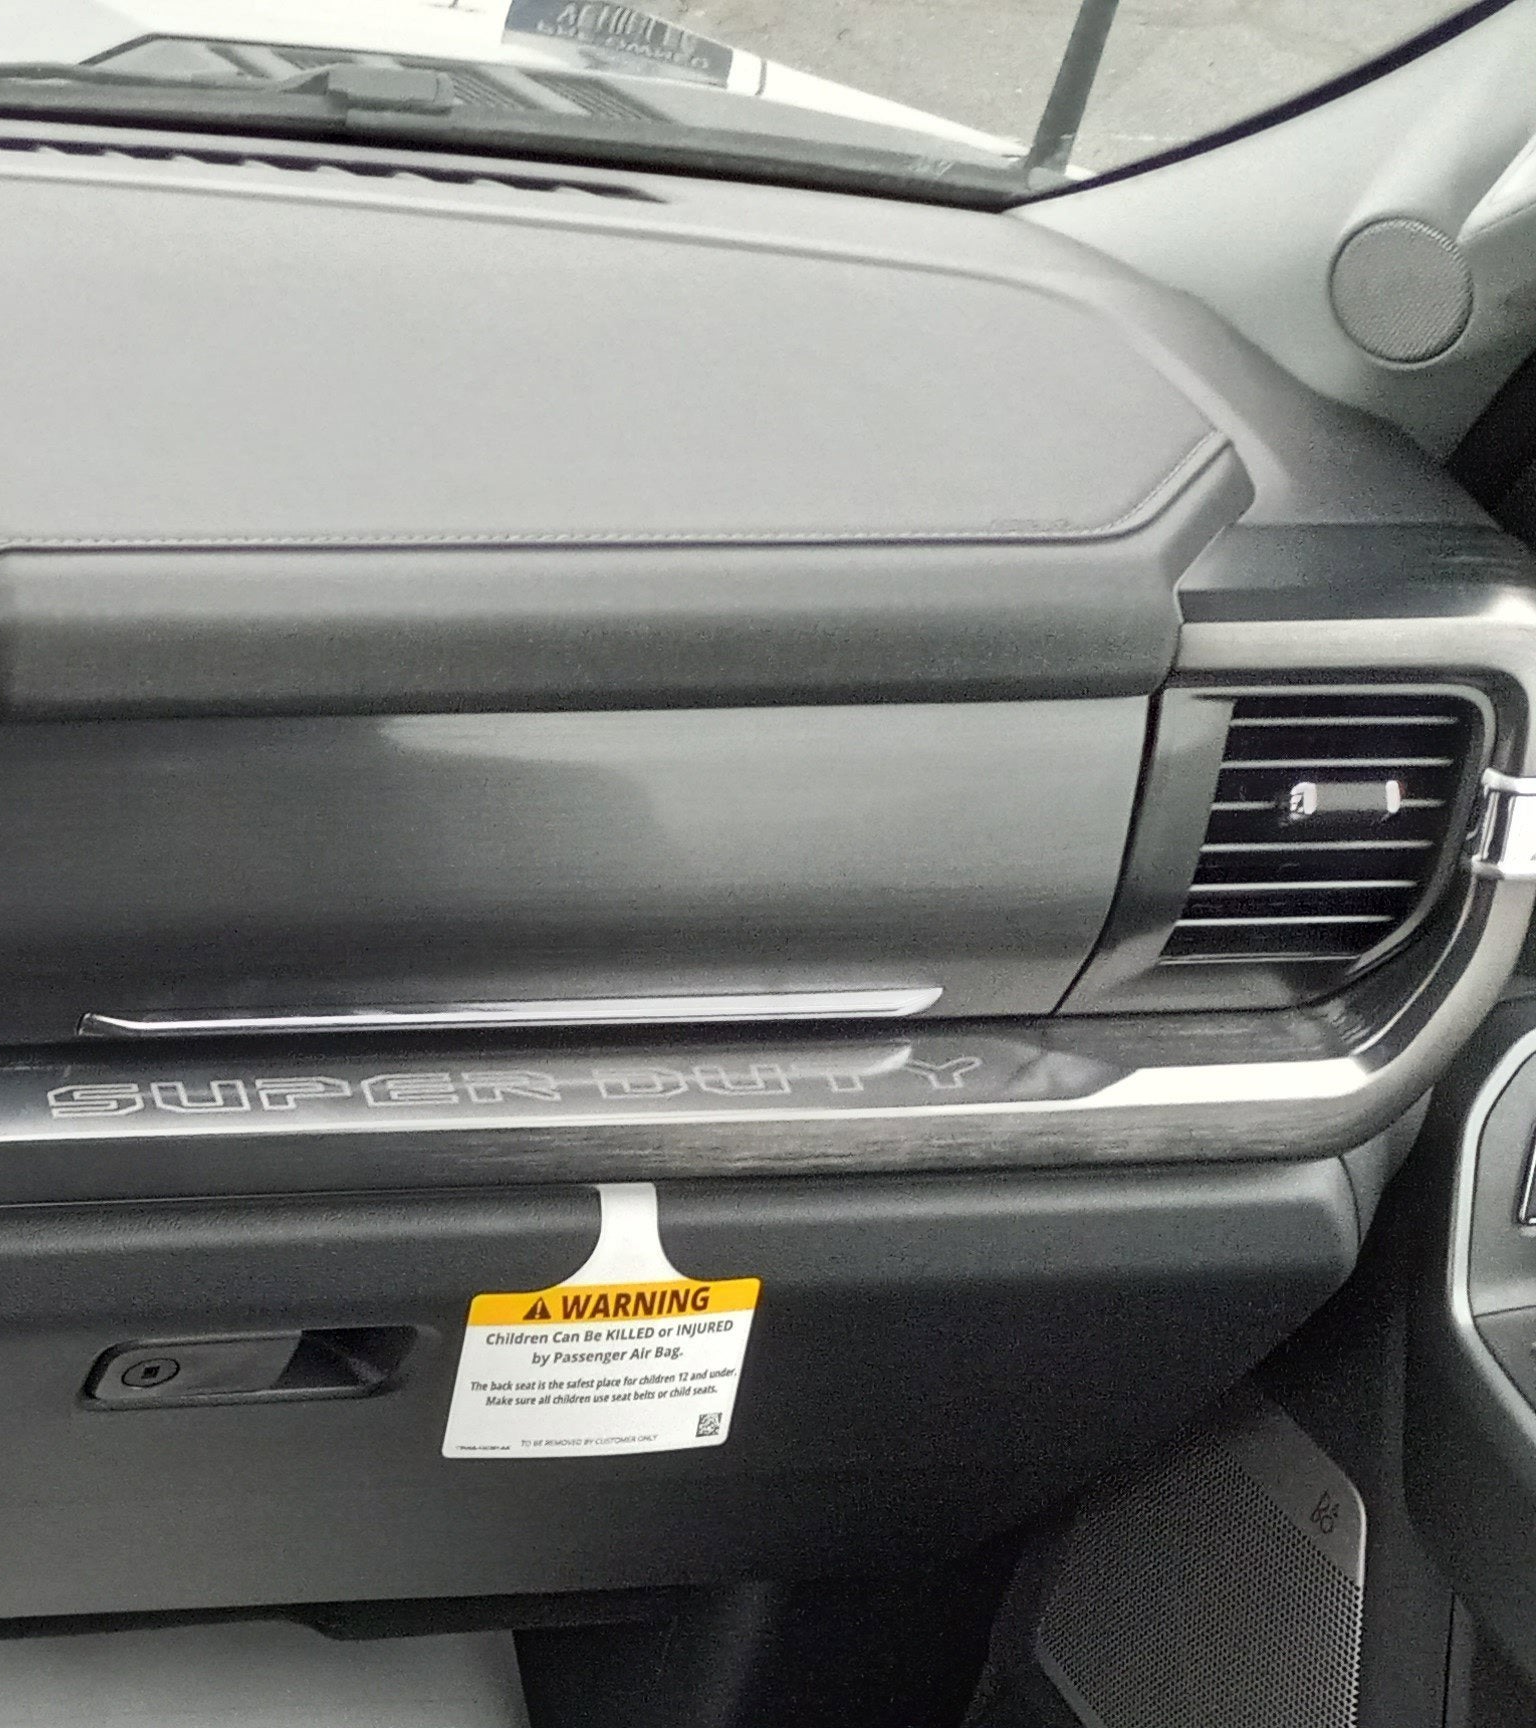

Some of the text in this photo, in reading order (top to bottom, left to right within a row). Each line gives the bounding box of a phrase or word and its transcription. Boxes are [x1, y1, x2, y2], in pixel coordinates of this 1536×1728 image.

[46, 1055, 983, 1118] SUPER DUTY
[561, 1286, 711, 1319] WARNING
[486, 1320, 734, 1345] Children Can Be KILLED or INJURED
[532, 1346, 684, 1367] by Passenger Air Bag.
[470, 1381, 488, 1392] The
[490, 1380, 512, 1391] back
[515, 1380, 536, 1391] seat
[537, 1380, 546, 1390] is
[548, 1379, 564, 1390] the
[566, 1377, 594, 1390] safest
[596, 1377, 622, 1390] place
[623, 1375, 637, 1387] for
[638, 1373, 675, 1386] children
[678, 1372, 689, 1382] 12
[690, 1370, 707, 1381] and
[485, 1395, 513, 1406] Make
[515, 1396, 536, 1406] sure
[538, 1394, 551, 1405] all
[553, 1393, 591, 1404] children
[593, 1394, 608, 1403] use
[610, 1392, 631, 1402] seat
[633, 1389, 655, 1401] belts
[669, 1386, 690, 1398] child
[544, 1438, 582, 1447] REMOVED
[595, 1436, 636, 1445] CUSTOMER
[638, 1434, 658, 1442] ONLY
